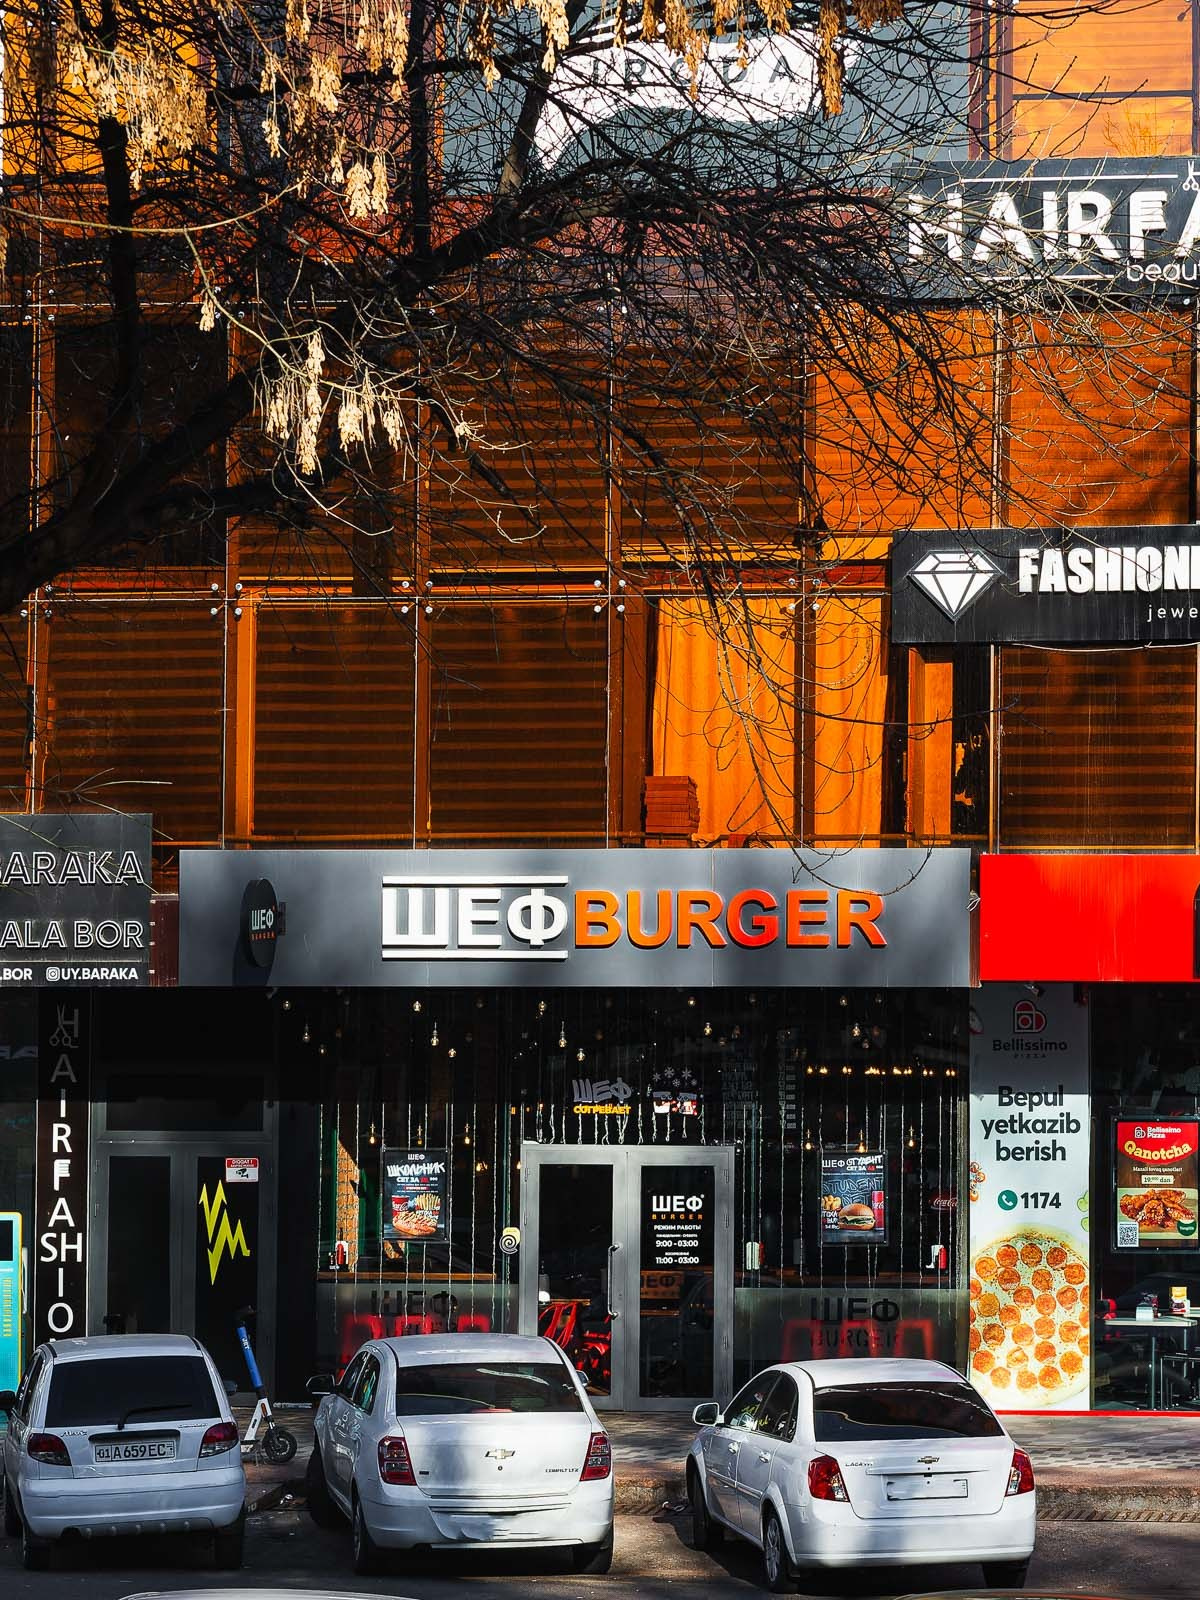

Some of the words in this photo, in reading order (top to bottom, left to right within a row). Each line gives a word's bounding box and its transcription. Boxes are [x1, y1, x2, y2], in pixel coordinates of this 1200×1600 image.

[0, 851, 144, 885] ARAKA
[251, 908, 274, 931] ШЕФ
[381, 886, 568, 948] ШЕФ
[574, 889, 889, 950] BURGER
[73, 920, 144, 949] BOR
[61, 967, 139, 980] UY.BARAKA
[992, 1038, 1068, 1051] Bellissimo
[572, 1077, 633, 1104] ШЕФ
[998, 1085, 1064, 1112] Bepul
[981, 1112, 1081, 1140] yetkazib
[996, 1139, 1067, 1161] berish
[1124, 1140, 1193, 1160] Qanotcha
[386, 1162, 446, 1177] ШКОЛЬНИК
[822, 1159, 846, 1168] ШЕФ
[652, 1195, 703, 1212] ШЕФ
[1020, 1192, 1062, 1209] 1174
[656, 1256, 673, 1264] 11:00
[678, 1256, 700, 1264] 03:00
[810, 1297, 900, 1325] ШЕФ
